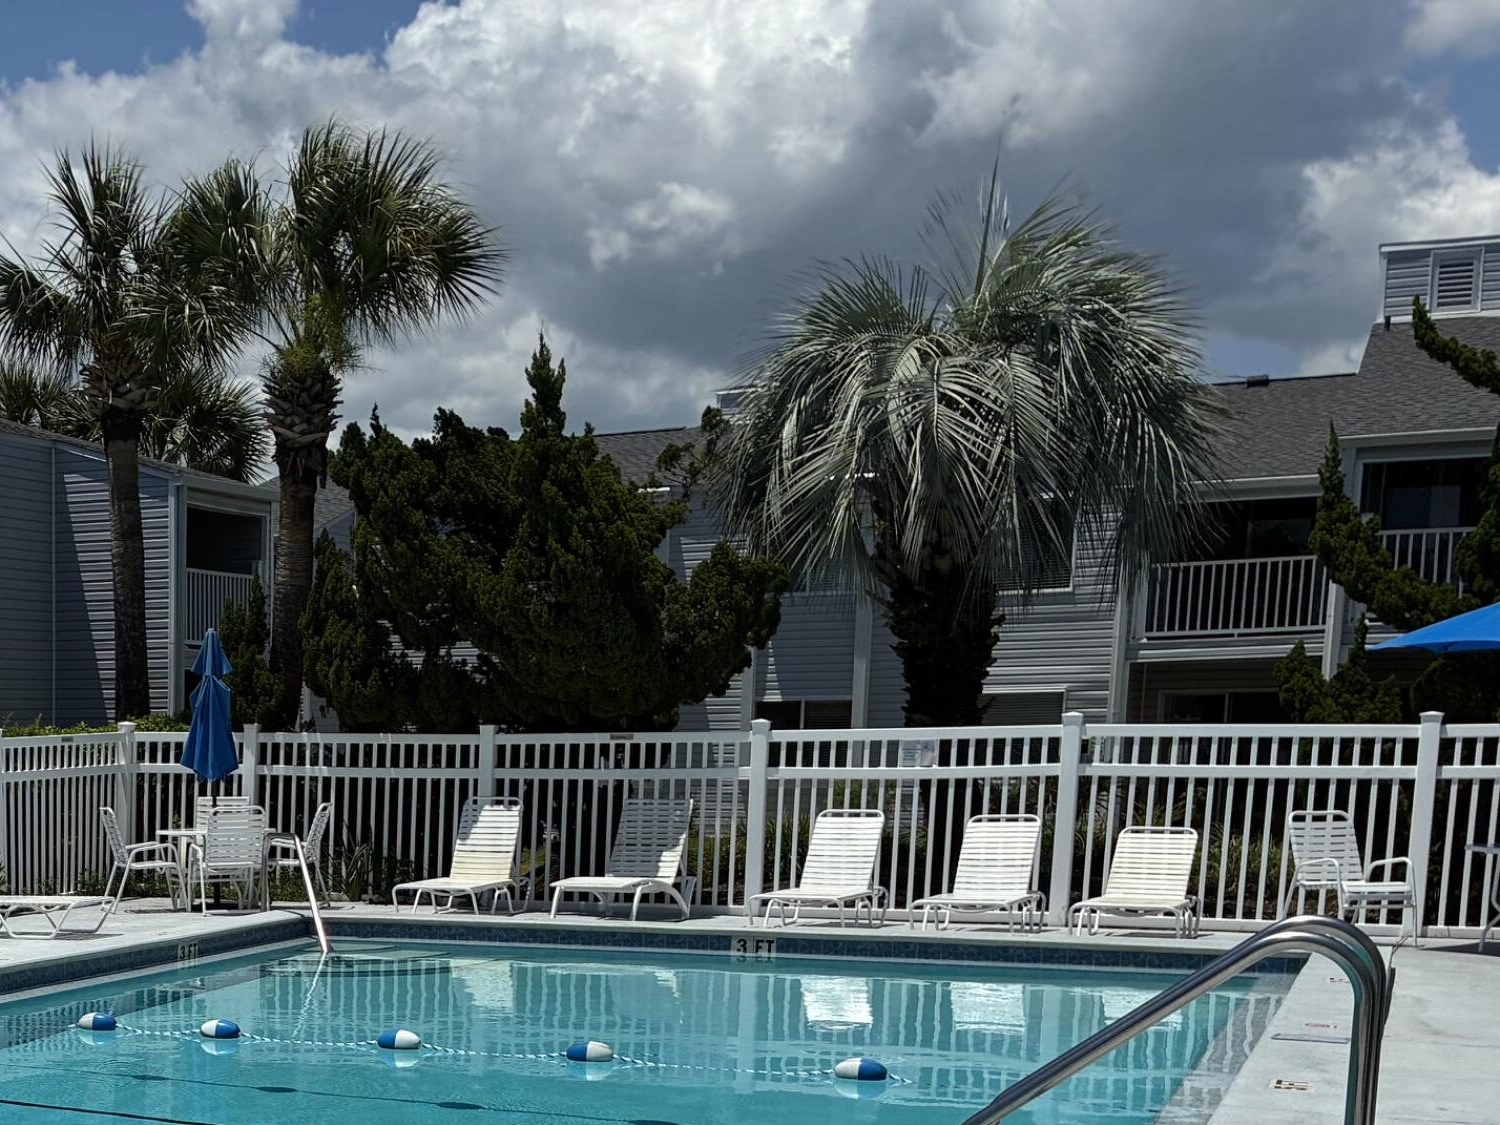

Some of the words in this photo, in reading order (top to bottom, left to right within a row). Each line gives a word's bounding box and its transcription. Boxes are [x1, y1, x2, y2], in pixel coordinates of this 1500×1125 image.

[180, 945, 186, 960] 3
[736, 938, 748, 953] 3
[755, 939, 775, 953] FT
